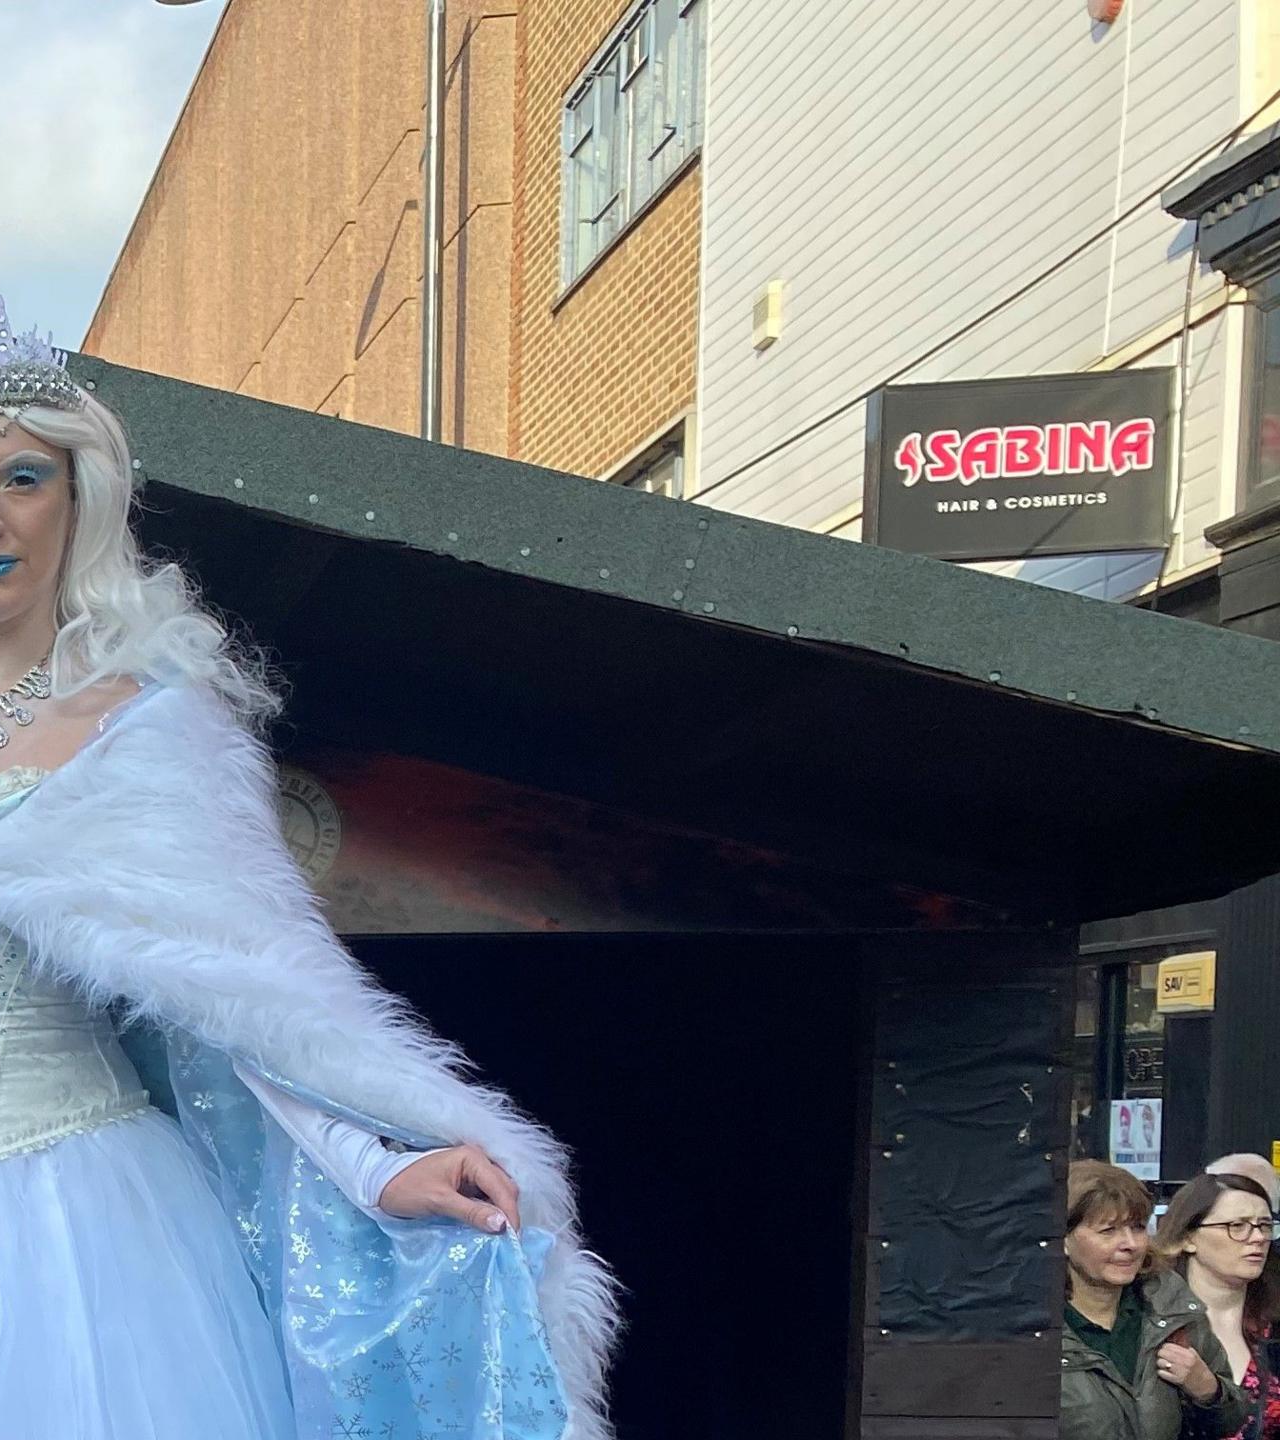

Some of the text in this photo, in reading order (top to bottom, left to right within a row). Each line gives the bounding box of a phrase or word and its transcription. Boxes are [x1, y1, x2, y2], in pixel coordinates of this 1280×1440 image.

[925, 418, 1155, 485] SABINA
[936, 491, 1108, 514] HAIR & COSMETICS
